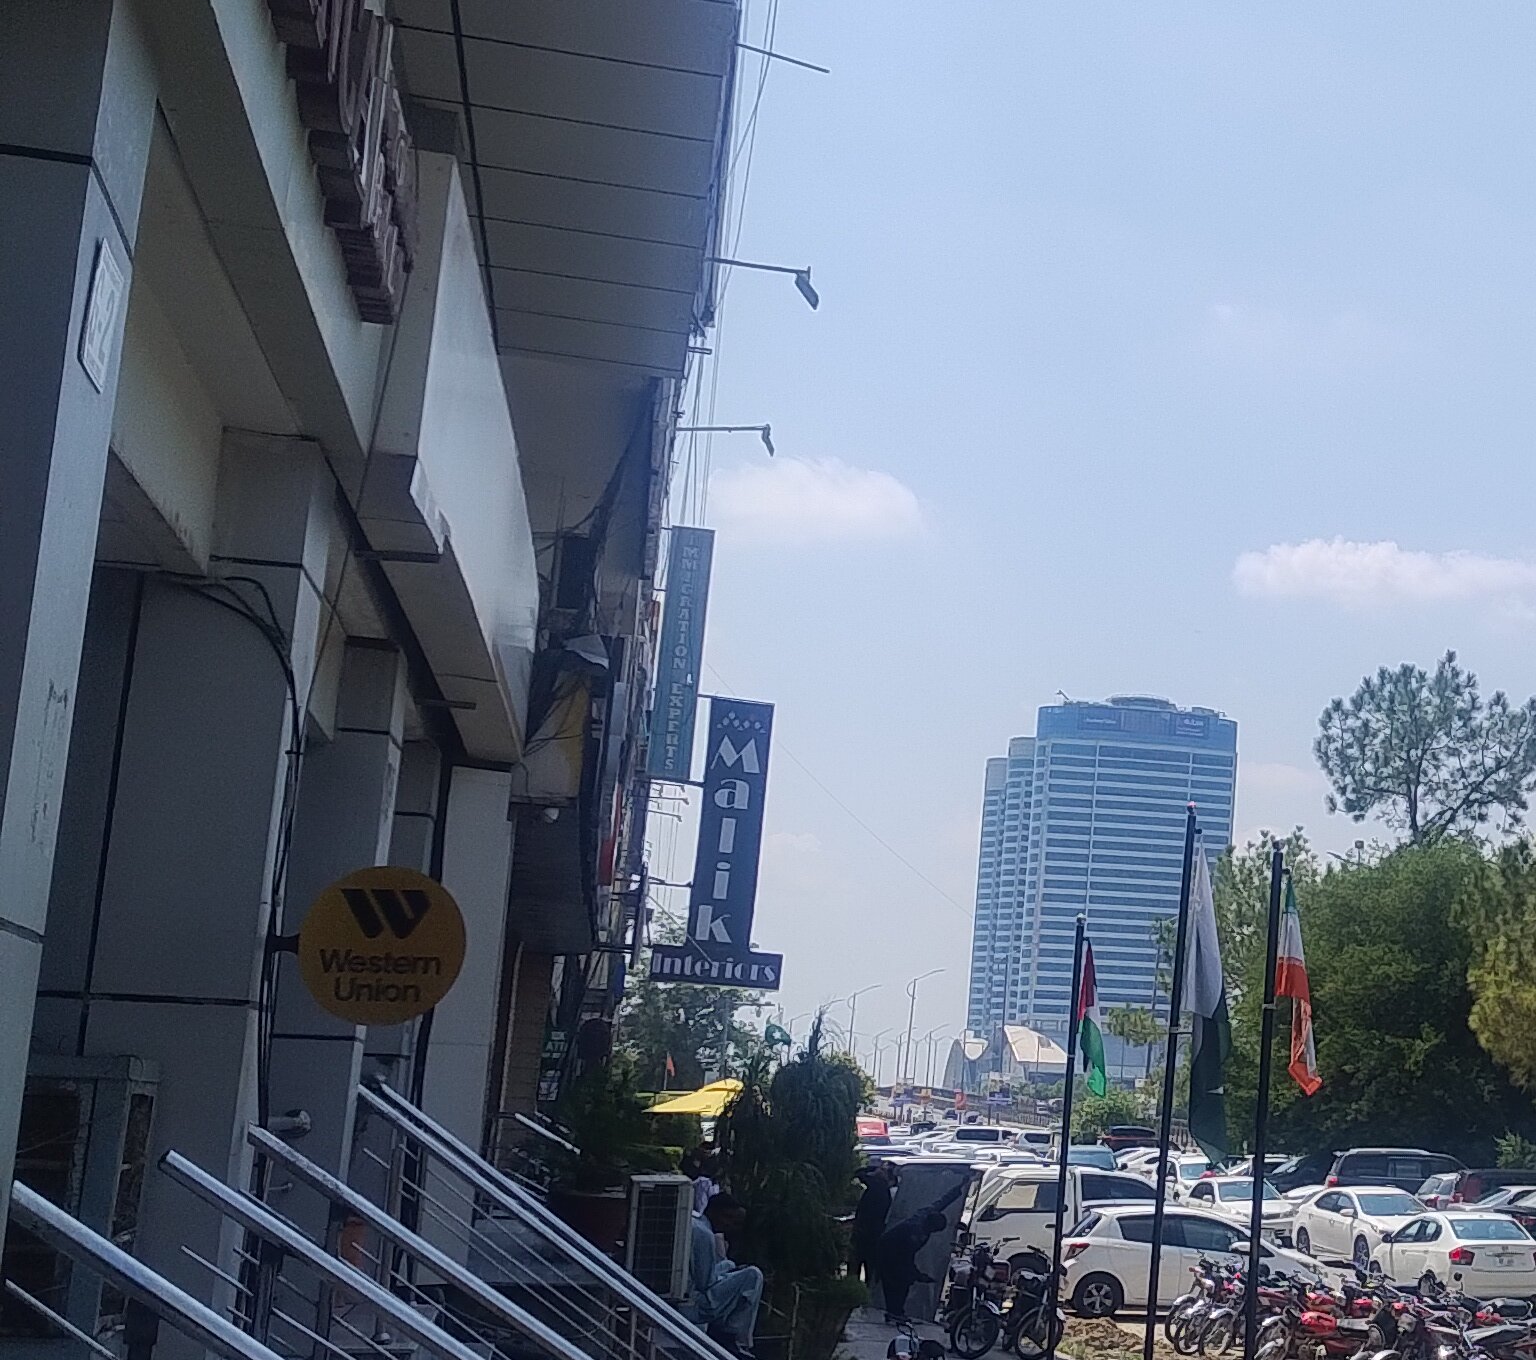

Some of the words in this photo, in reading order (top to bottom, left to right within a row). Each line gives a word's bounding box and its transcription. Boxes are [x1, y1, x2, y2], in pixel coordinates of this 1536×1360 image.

[673, 534, 699, 669] IMMIGRATION
[664, 682, 684, 770] EXPERTS
[695, 734, 762, 944] Malik
[319, 948, 442, 976] Western
[334, 976, 421, 1003] Union
[652, 952, 776, 981] Interiors
